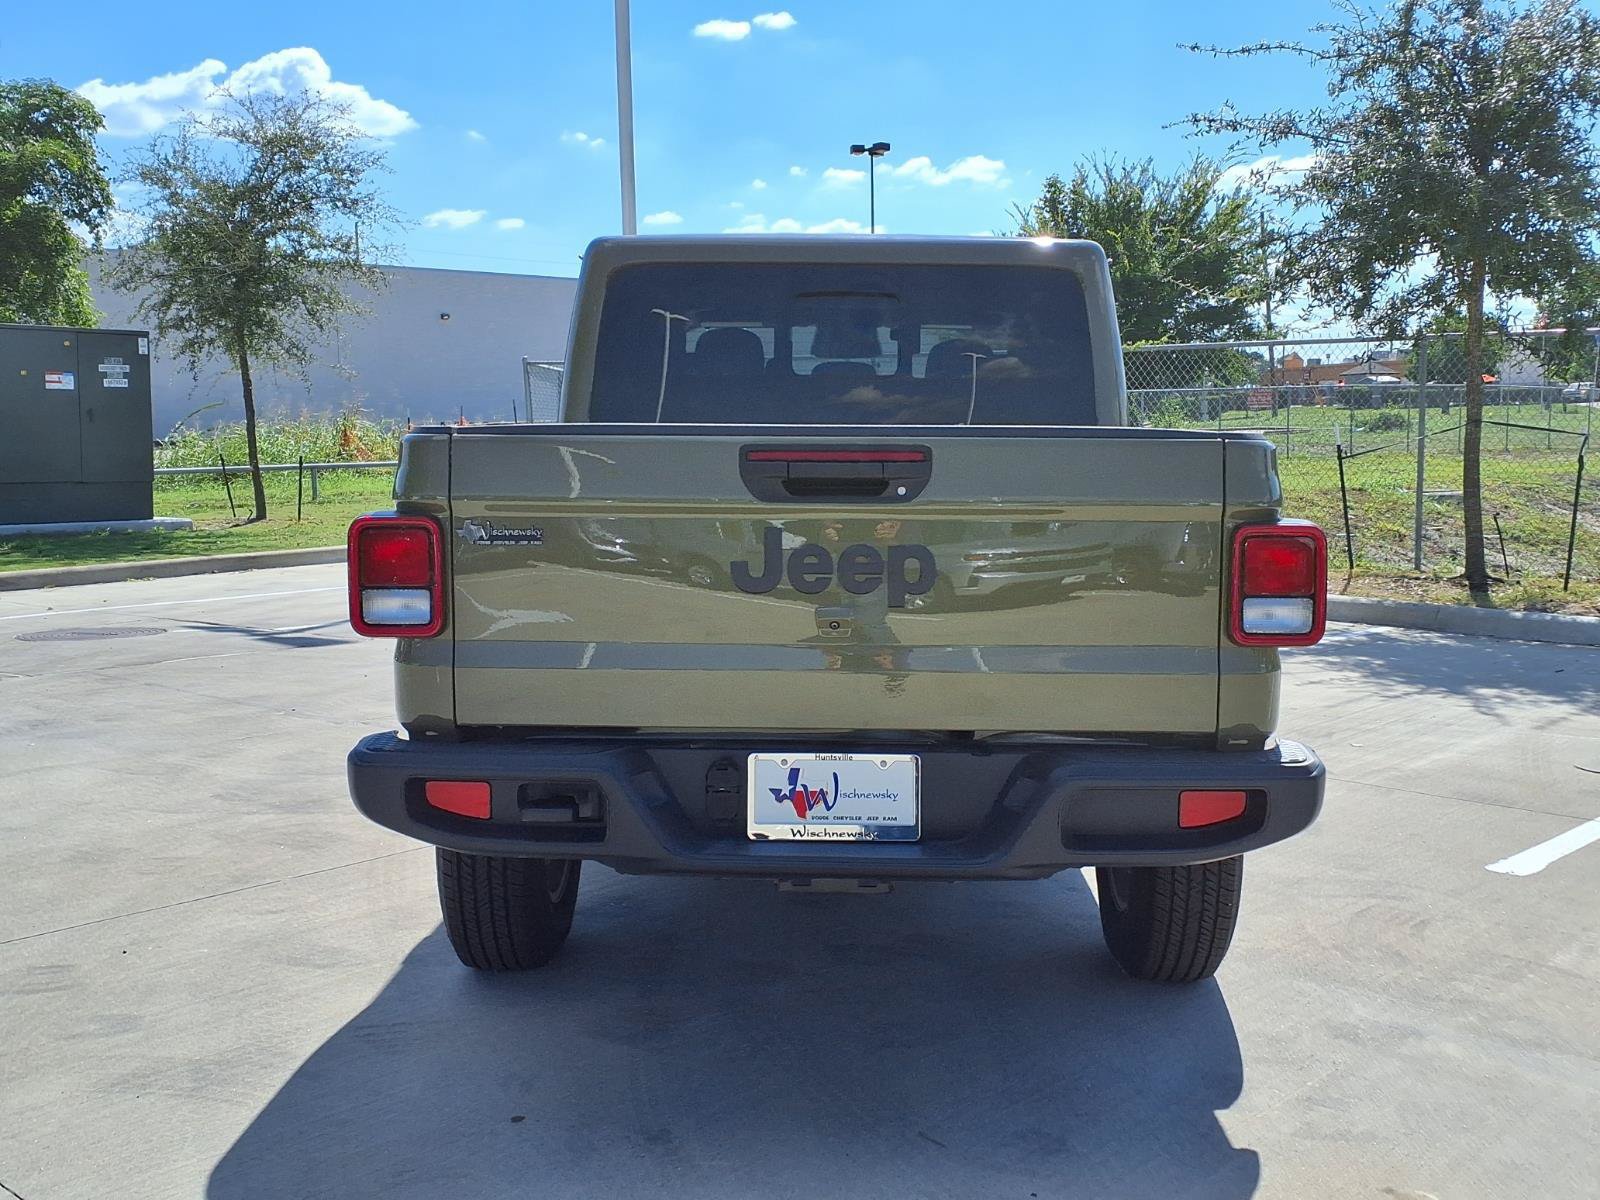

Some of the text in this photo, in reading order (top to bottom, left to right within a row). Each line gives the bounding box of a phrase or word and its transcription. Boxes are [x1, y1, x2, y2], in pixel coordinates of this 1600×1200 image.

[730, 526, 936, 608] Jeep
[815, 753, 853, 761] Huntsville
[800, 772, 899, 811] Wischnewsky
[791, 825, 878, 839] Wischnewsky
